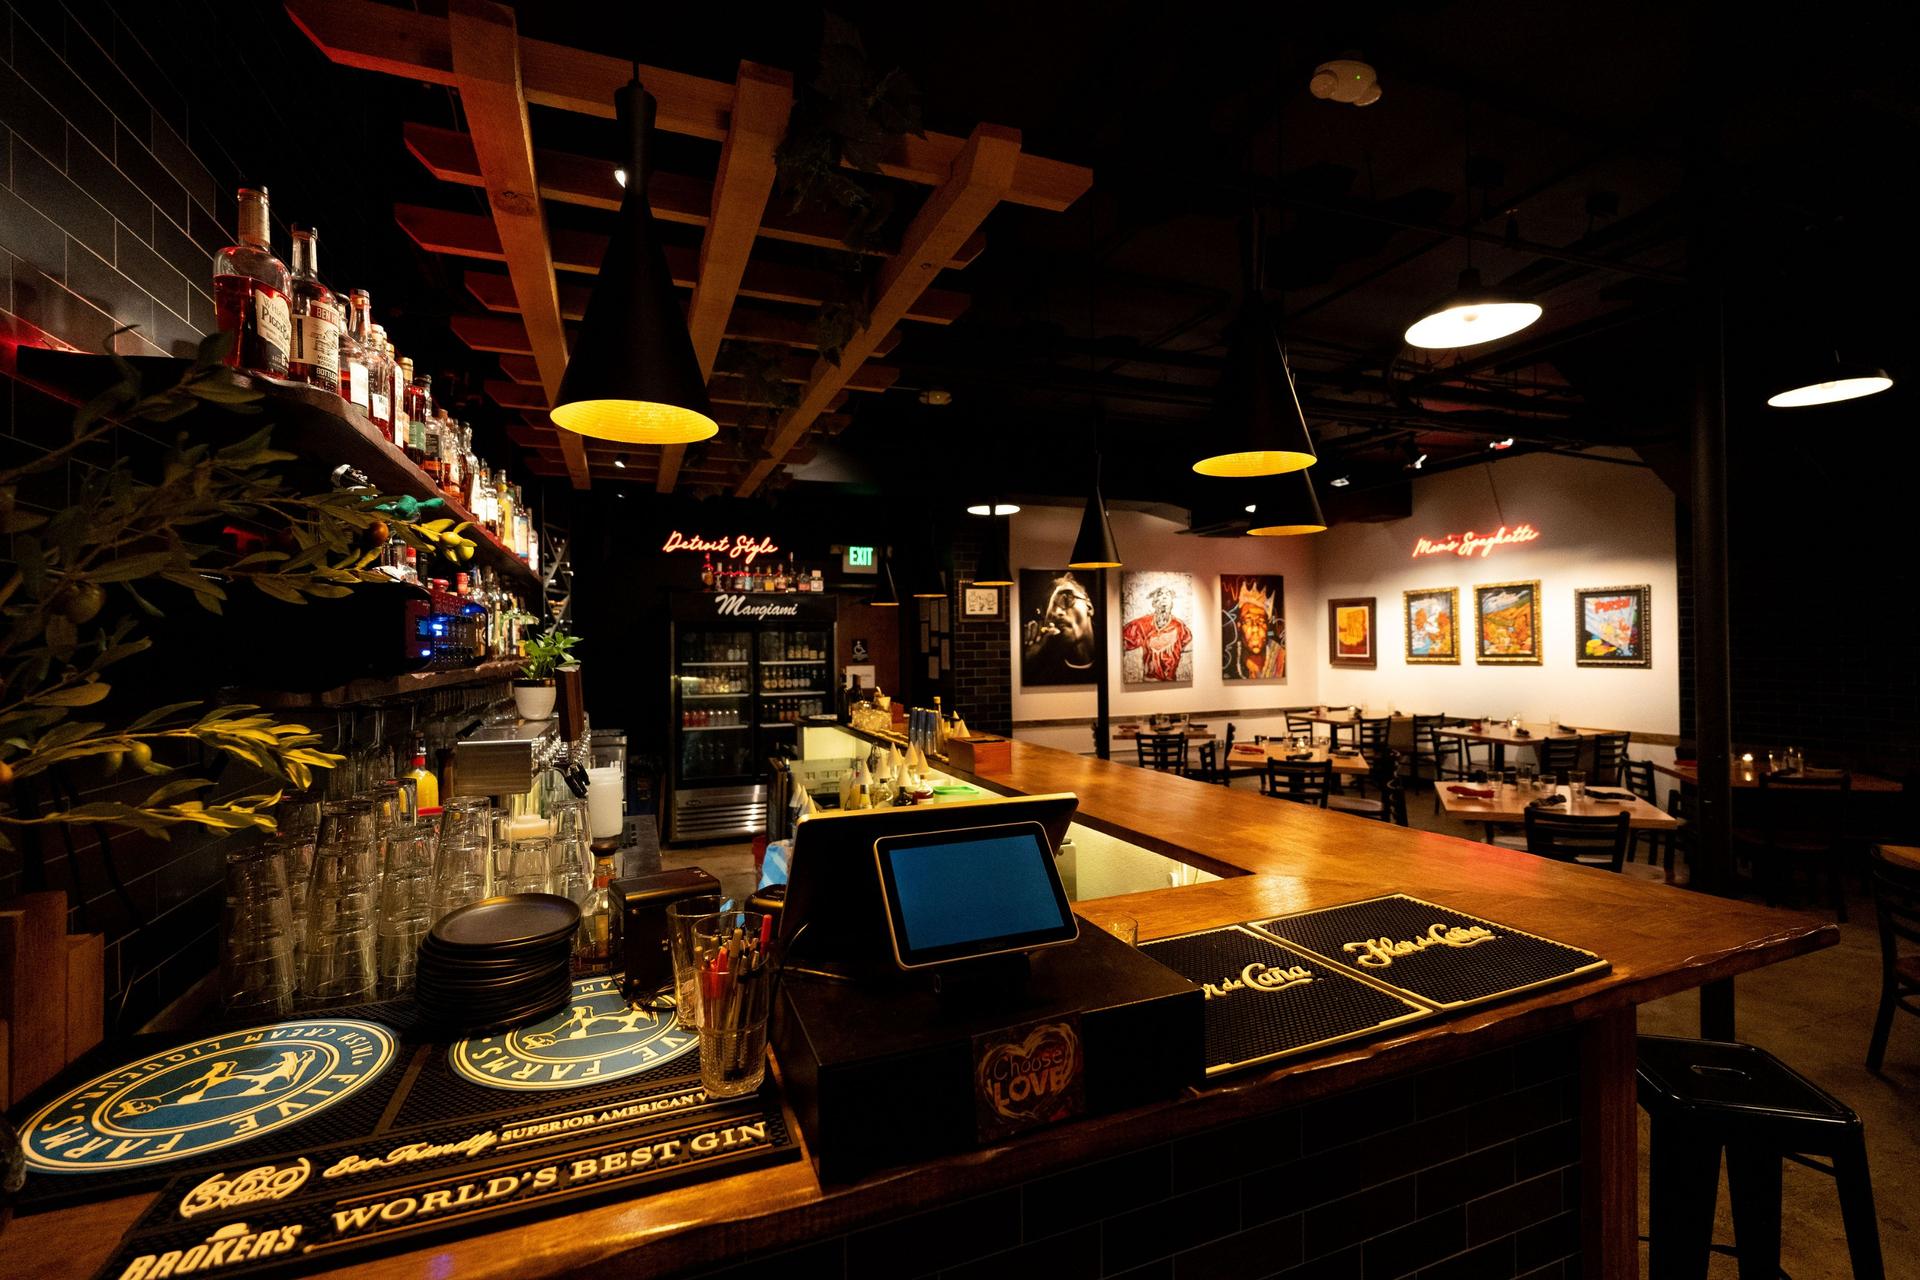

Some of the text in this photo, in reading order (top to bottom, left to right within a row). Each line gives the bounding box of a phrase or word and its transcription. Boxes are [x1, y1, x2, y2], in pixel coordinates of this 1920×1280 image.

[662, 530, 779, 565] Detroit Style
[849, 546, 874, 566] EXIT
[1411, 524, 1541, 558] Mom's Spaghetti
[714, 593, 799, 621] Mangiami
[1343, 936, 1425, 968] Flor
[1222, 977, 1245, 992] de
[1241, 962, 1313, 992] Caña
[78, 1027, 373, 1100] IRISH CREAM LIQUEUR
[472, 1046, 602, 1080] FARMS
[993, 1050, 1064, 1080] Choose
[994, 1067, 1066, 1108] LOVE
[40, 1074, 360, 1159] FIVE FARMS
[501, 1114, 595, 1142] SUPERIOR
[599, 1094, 694, 1123] AMERICAN
[184, 1161, 308, 1216] 360
[331, 1121, 767, 1233] WORLD'S BEST GIN
[118, 1224, 304, 1280] BROKER'S
